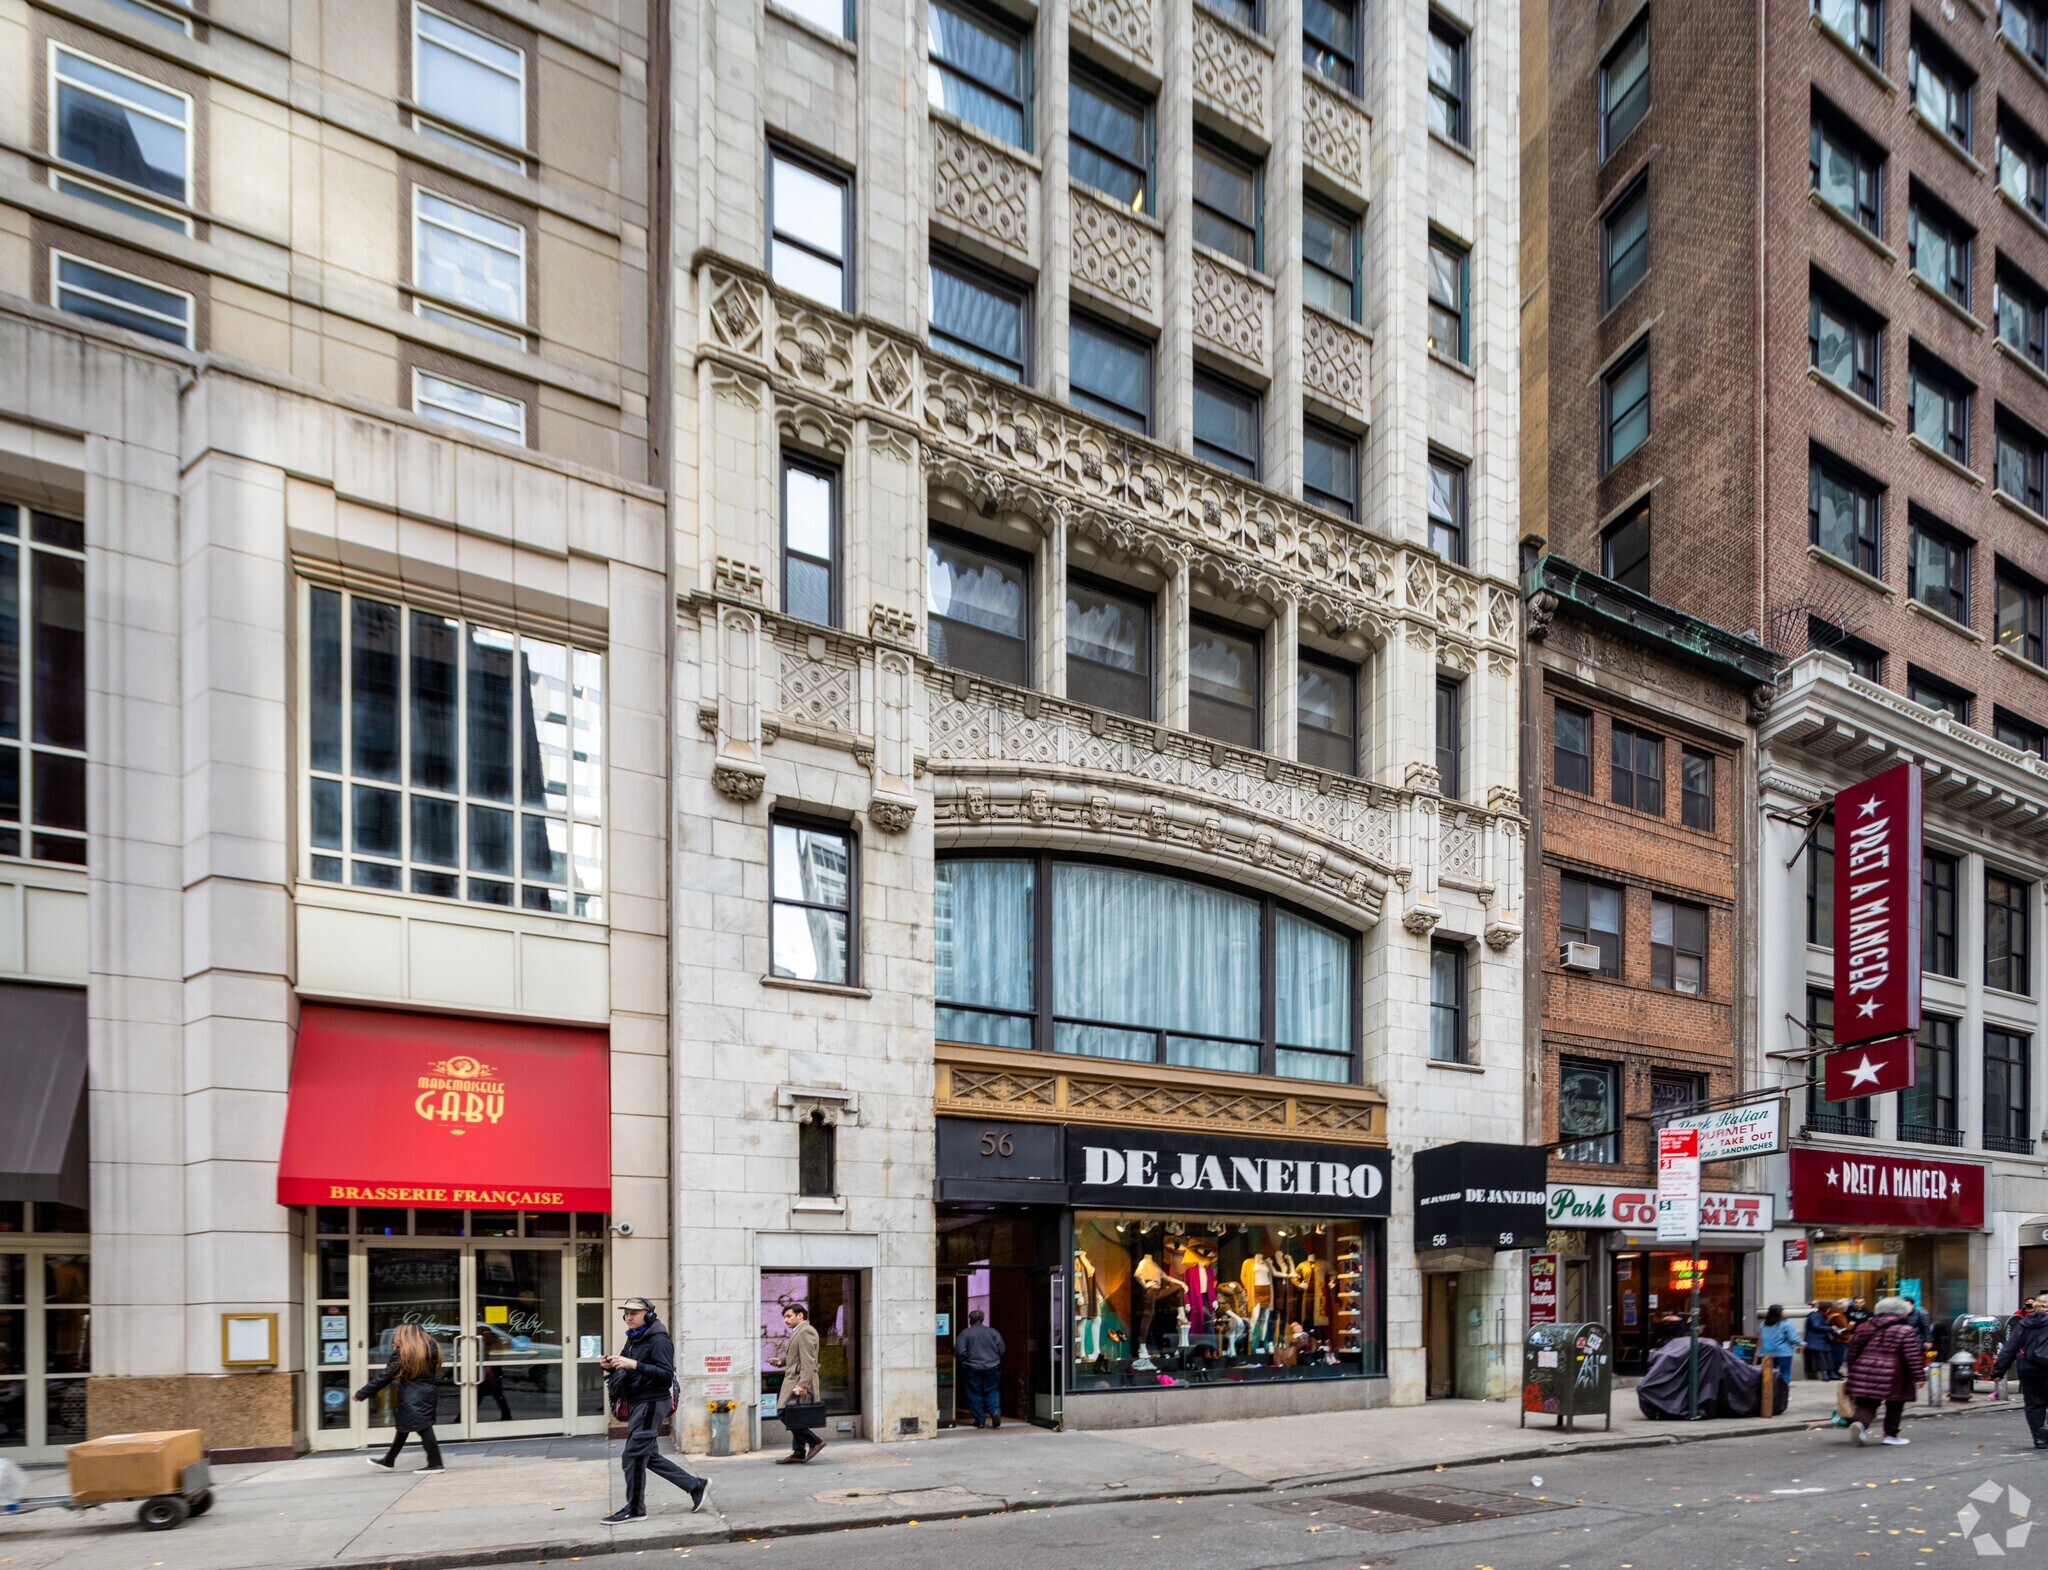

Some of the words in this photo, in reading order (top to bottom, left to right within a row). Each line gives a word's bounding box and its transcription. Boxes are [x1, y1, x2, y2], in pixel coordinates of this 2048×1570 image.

[1850, 815, 1891, 877] PRET
[1850, 879, 1890, 900] A
[1849, 896, 1890, 996] MANGER
[417, 1076, 505, 1095] MADEMOISELLE
[414, 1090, 505, 1124] GABY
[1716, 1109, 1769, 1127] Italian
[1699, 1123, 1757, 1141] OURMET
[1720, 1136, 1744, 1147] TAKE
[1751, 1131, 1773, 1142] OUT
[980, 1131, 1015, 1158] 56
[1721, 1141, 1773, 1155] SANDWICHES
[1081, 1146, 1158, 1188] DE
[1170, 1152, 1384, 1199] JANEIRO
[1843, 1160, 1876, 1195] PRET
[1879, 1166, 1888, 1196] A
[1893, 1167, 1948, 1200] MANGER
[329, 1185, 448, 1201] BRASSERIE
[452, 1189, 564, 1206] FRANÇAISE
[1431, 1192, 1462, 1204] JANEIRO
[1465, 1188, 1486, 1203] DE
[1487, 1189, 1547, 1205] JANEIRO
[1547, 1187, 1606, 1219] Park
[1612, 1193, 1760, 1226] GOMET
[1661, 1201, 1669, 1210] 5
[1432, 1233, 1447, 1247] 56
[1499, 1232, 1514, 1245] 56
[508, 1309, 555, 1336] Gaby
[328, 1344, 343, 1357] A
